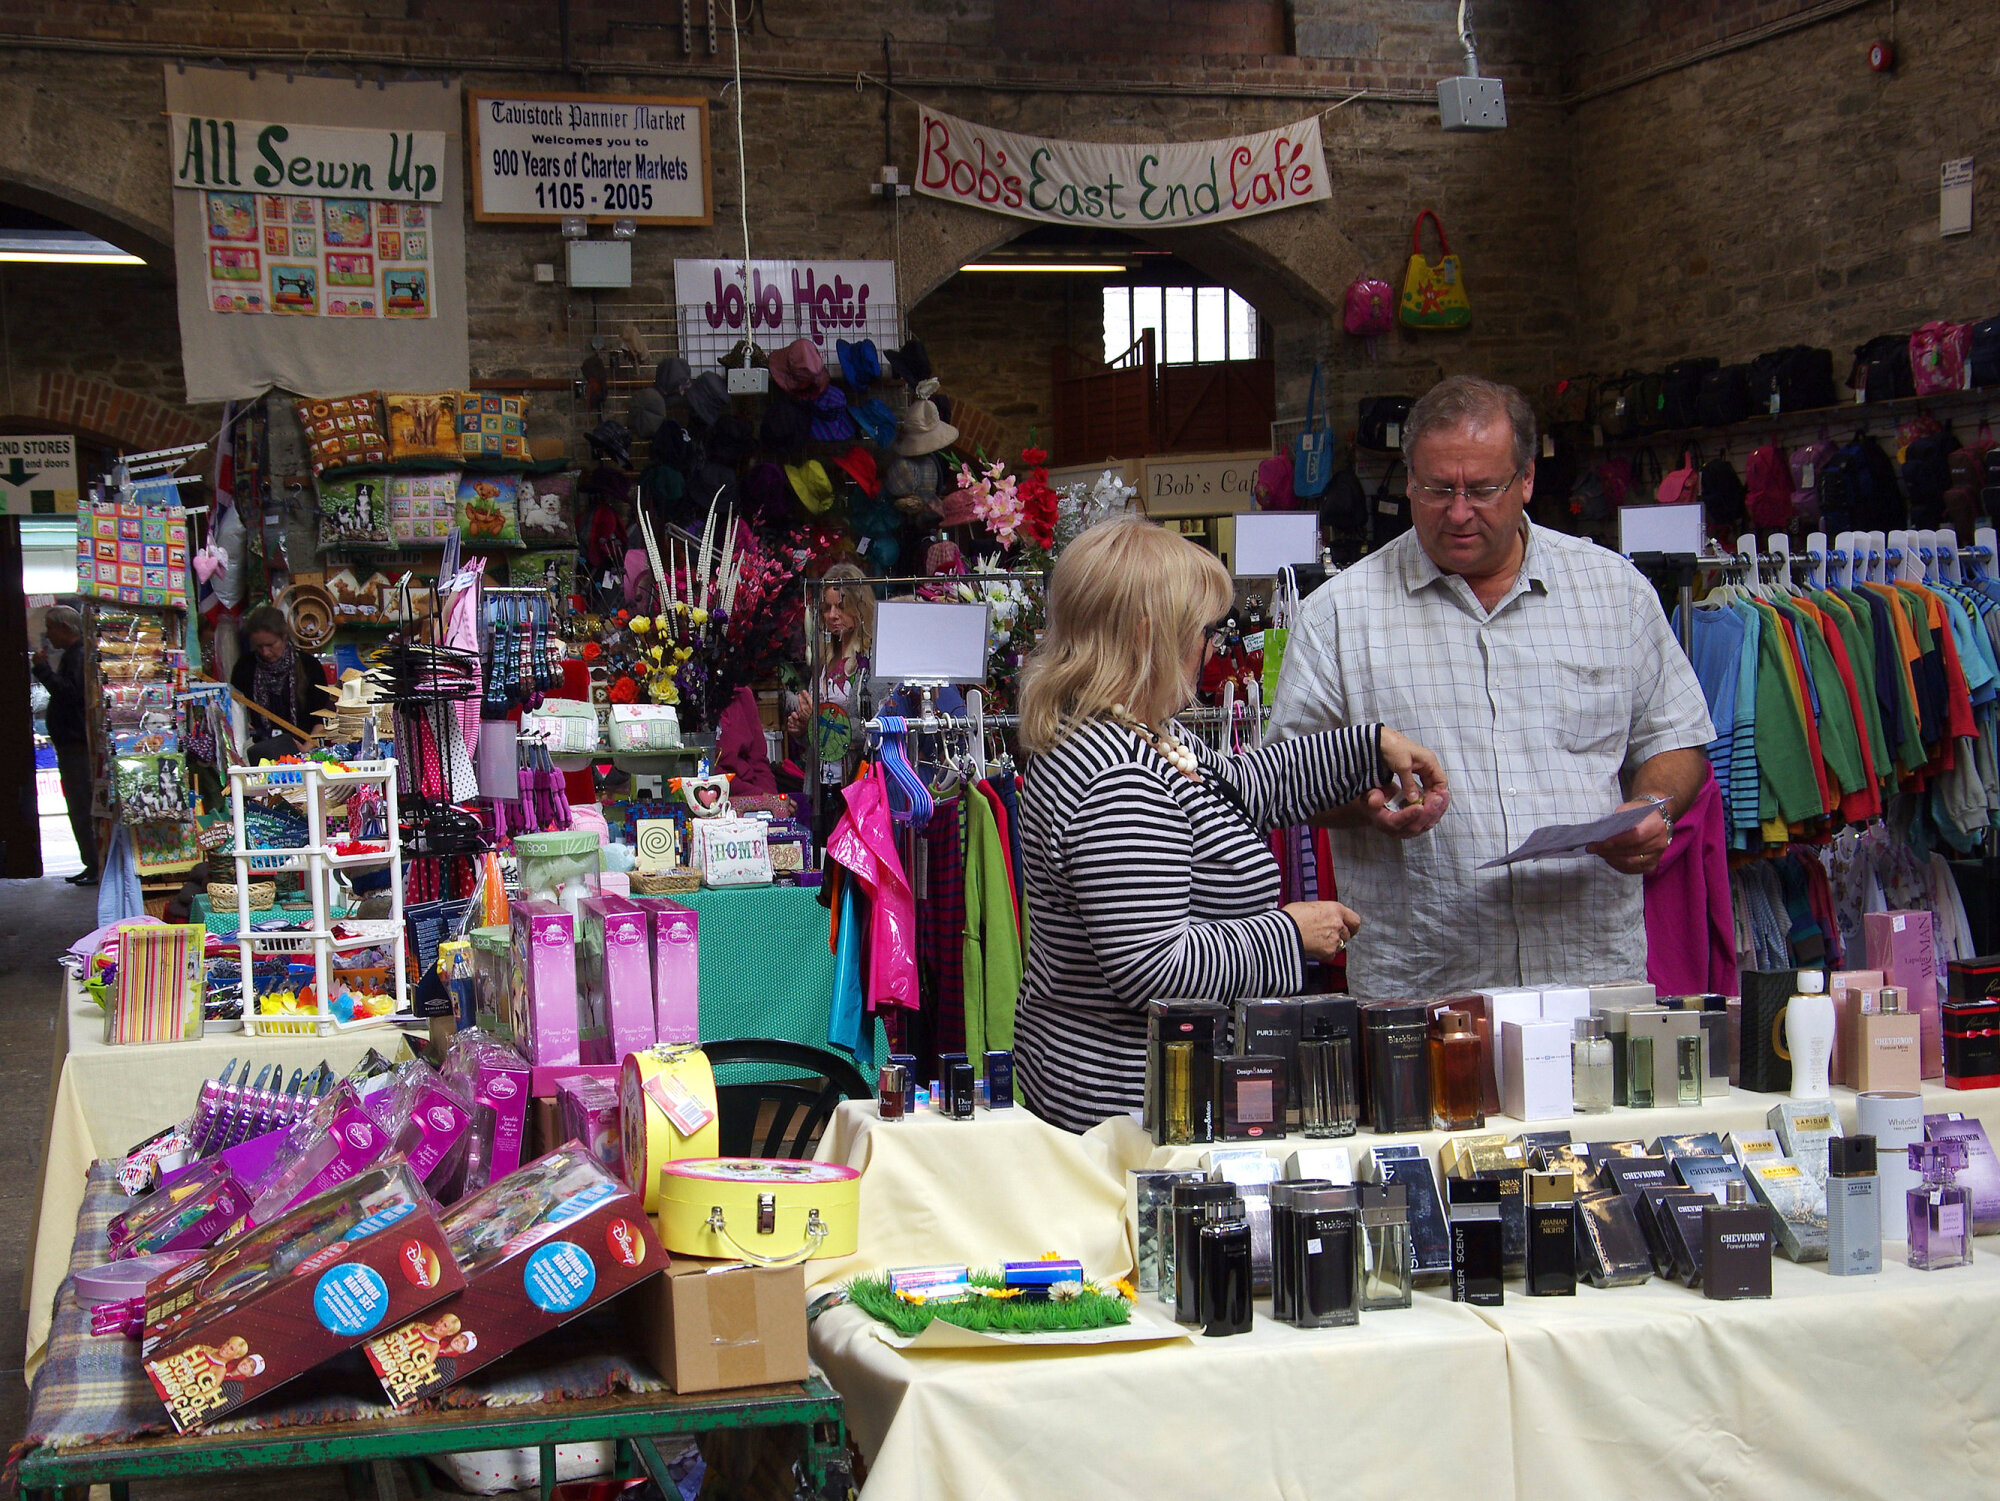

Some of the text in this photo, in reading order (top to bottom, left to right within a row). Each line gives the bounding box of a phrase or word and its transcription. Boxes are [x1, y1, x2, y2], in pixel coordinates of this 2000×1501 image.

[491, 101, 686, 131] Tavistock Pannier Market
[532, 134, 649, 148] Welcomes you to
[179, 117, 436, 200] All Sewn Up
[493, 149, 688, 181] 900 Years of Charter Markets
[921, 115, 1023, 209] Bob's
[1028, 148, 1126, 220] East
[1138, 153, 1220, 221] End
[535, 182, 585, 209] 1105
[604, 183, 653, 210] 2005
[791, 267, 870, 346] Hats
[0, 440, 71, 455] ND STORES
[25, 458, 70, 468] end doors
[1153, 469, 1258, 497] Bob's Caf
[527, 841, 548, 855] Spa
[713, 839, 763, 861] HOME
[1918, 916, 1932, 979] WOMAN
[491, 1084, 515, 1096] Disney
[957, 1097, 972, 1106] Dior
[1796, 1117, 1829, 1126] LAPIDUS
[1622, 1169, 1666, 1180] CHEVIGNON
[1456, 1227, 1465, 1263] SCENT
[1720, 1232, 1766, 1243] CHEVIGNON
[551, 1253, 584, 1290] HAIR SET
[563, 1248, 589, 1279] JUMBO
[342, 1274, 377, 1312] HAIR SET
[354, 1270, 381, 1301] JUMBO
[384, 1331, 424, 1394] SCHOOL
[398, 1322, 442, 1386] HIGH
[168, 1354, 210, 1418] SCHOOL
[182, 1344, 228, 1410] HIGH
[371, 1339, 411, 1402] MUSICAL
[154, 1361, 196, 1427] MUSICAL
